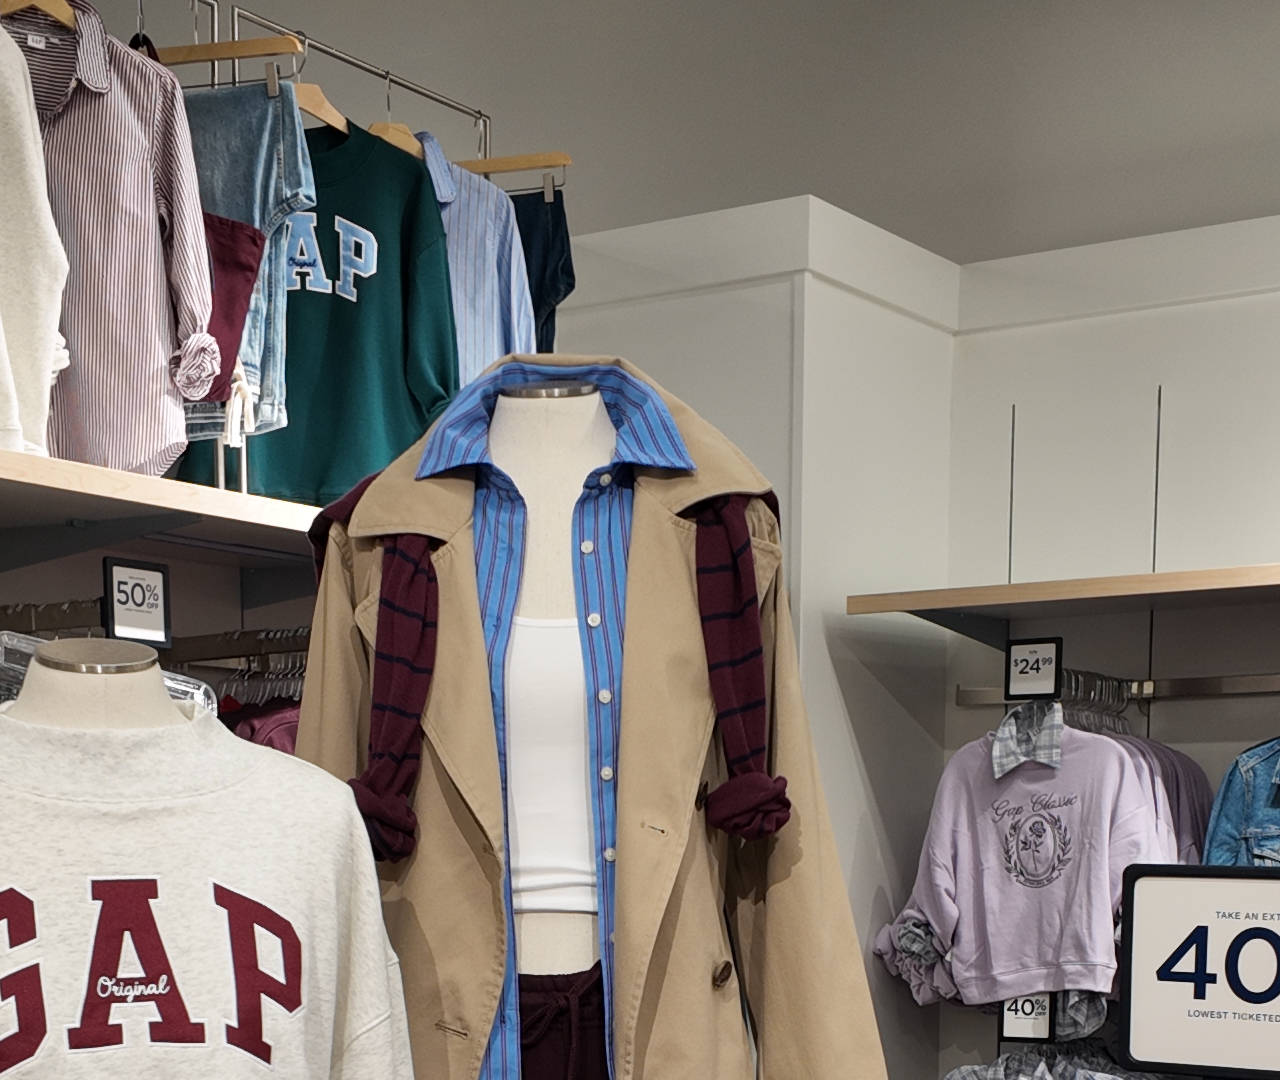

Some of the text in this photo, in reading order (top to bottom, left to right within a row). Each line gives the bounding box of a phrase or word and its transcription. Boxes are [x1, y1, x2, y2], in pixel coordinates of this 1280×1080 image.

[284, 211, 378, 303] AP
[117, 580, 159, 608] 50%
[991, 792, 1078, 824] Gap Classic
[1215, 911, 1241, 920] TAKE
[1244, 912, 1259, 921] AN
[96, 974, 171, 1003] Original
[1006, 998, 1047, 1016] 40%
[1187, 1009, 1228, 1020] LOWEST
